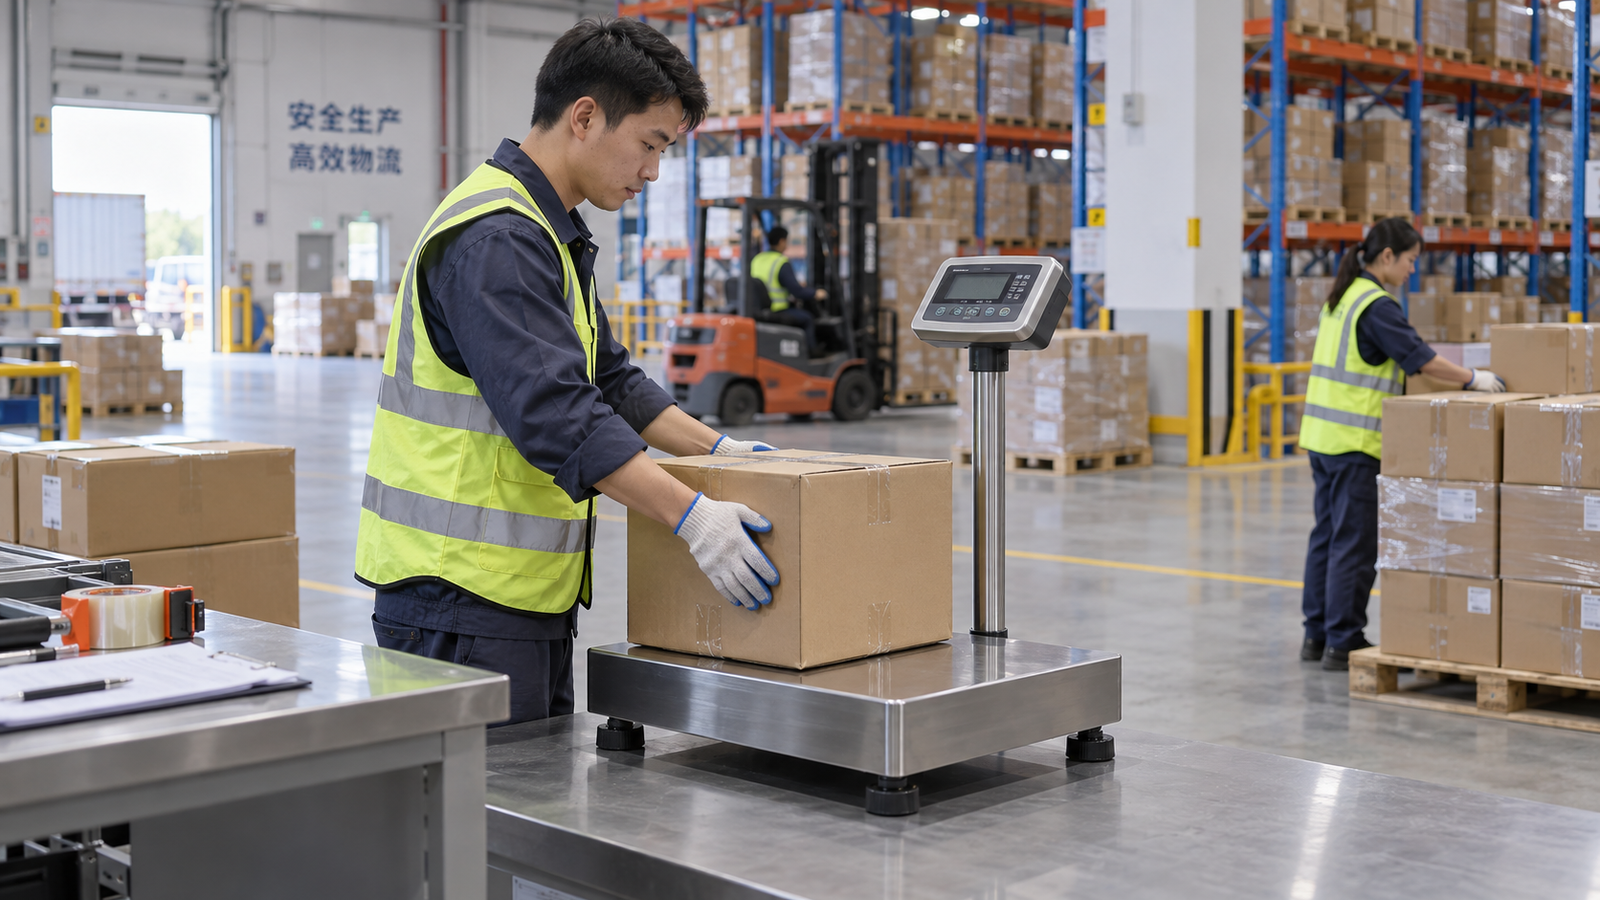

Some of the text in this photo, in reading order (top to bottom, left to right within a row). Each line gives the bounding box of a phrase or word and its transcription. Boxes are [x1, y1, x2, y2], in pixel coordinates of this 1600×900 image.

[288, 100, 402, 135] 安全生产
[288, 141, 403, 175] 高效物流
